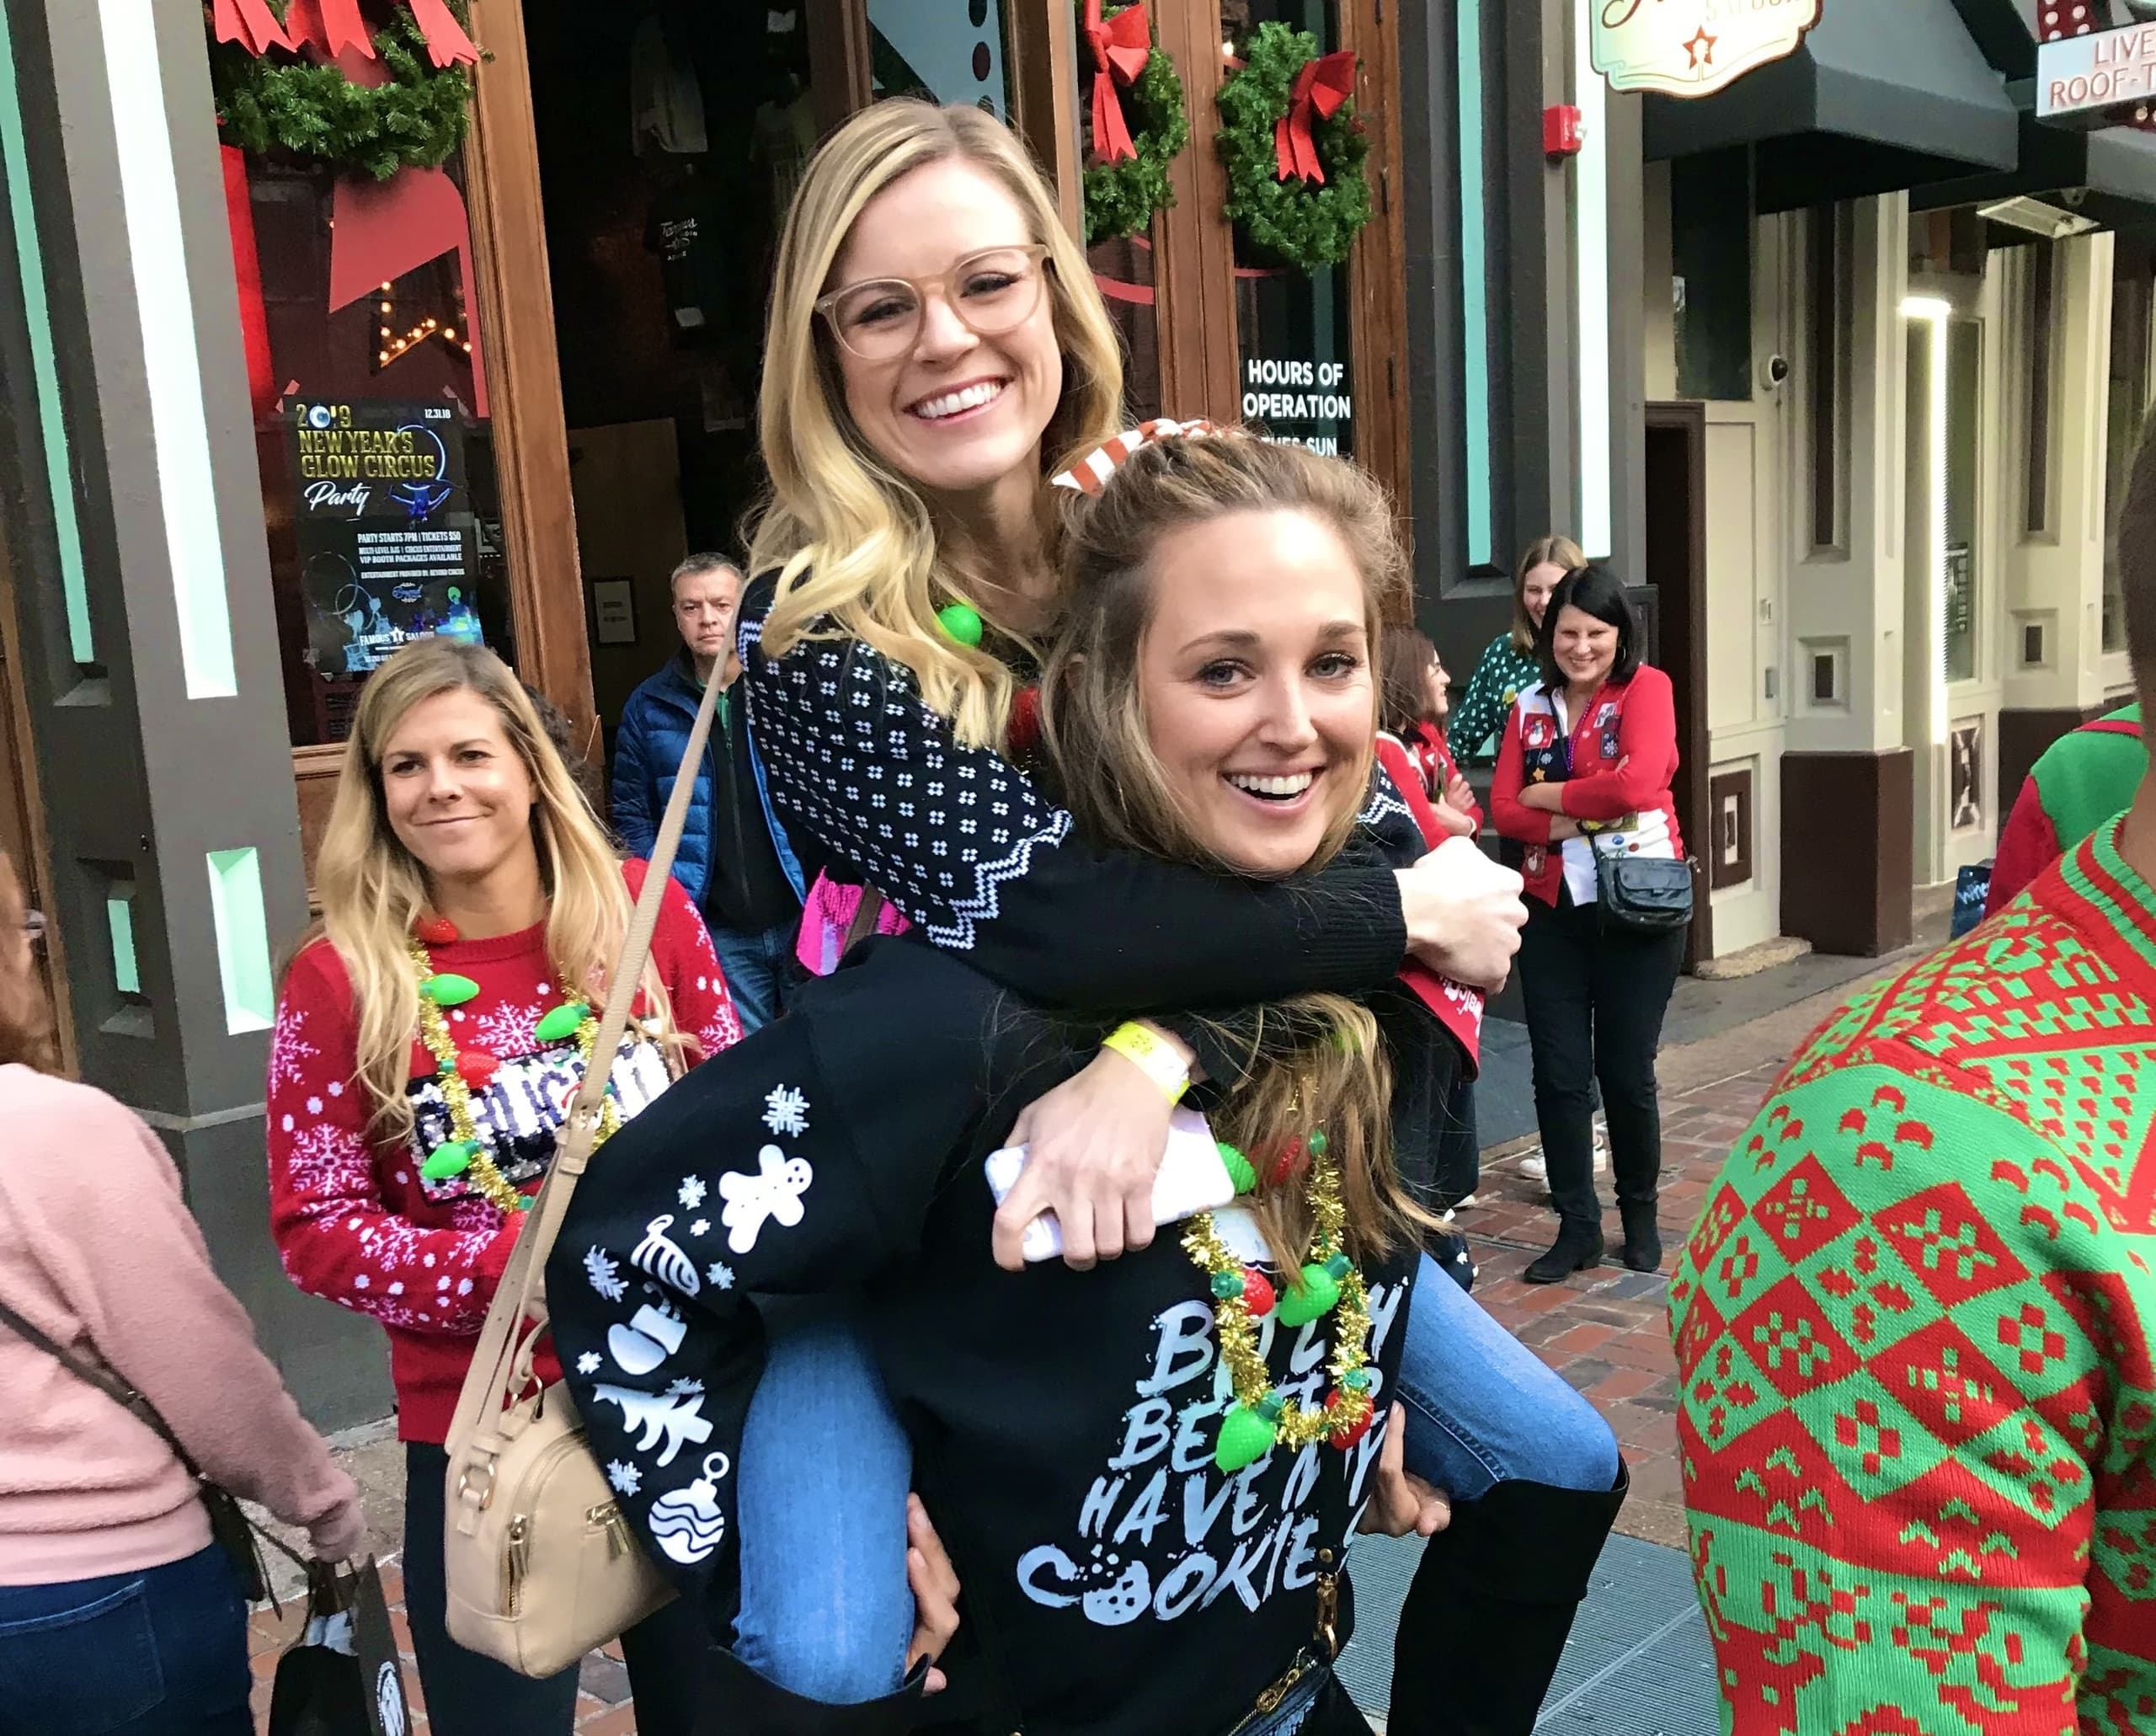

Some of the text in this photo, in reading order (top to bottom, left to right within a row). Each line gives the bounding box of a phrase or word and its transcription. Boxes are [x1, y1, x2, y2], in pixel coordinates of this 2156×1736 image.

[2095, 28, 2156, 64] LIVE
[1248, 359, 1343, 386] HOURS OF
[424, 408, 451, 419] 12.31.18
[1242, 393, 1351, 419] OPERATION
[298, 430, 344, 453] NEW
[302, 455, 436, 478] GLOW CIRCUS
[304, 481, 372, 516] Party
[357, 533, 378, 543] PARTY
[379, 532, 403, 542] STARTS
[403, 532, 419, 542] 7PM
[421, 531, 448, 542] TICKETS
[360, 553, 462, 564] VIP BOOTH PACKAGES AVAILABLE
[359, 633, 390, 646] FAMOUS
[1078, 1438, 1274, 1545] HAVE
